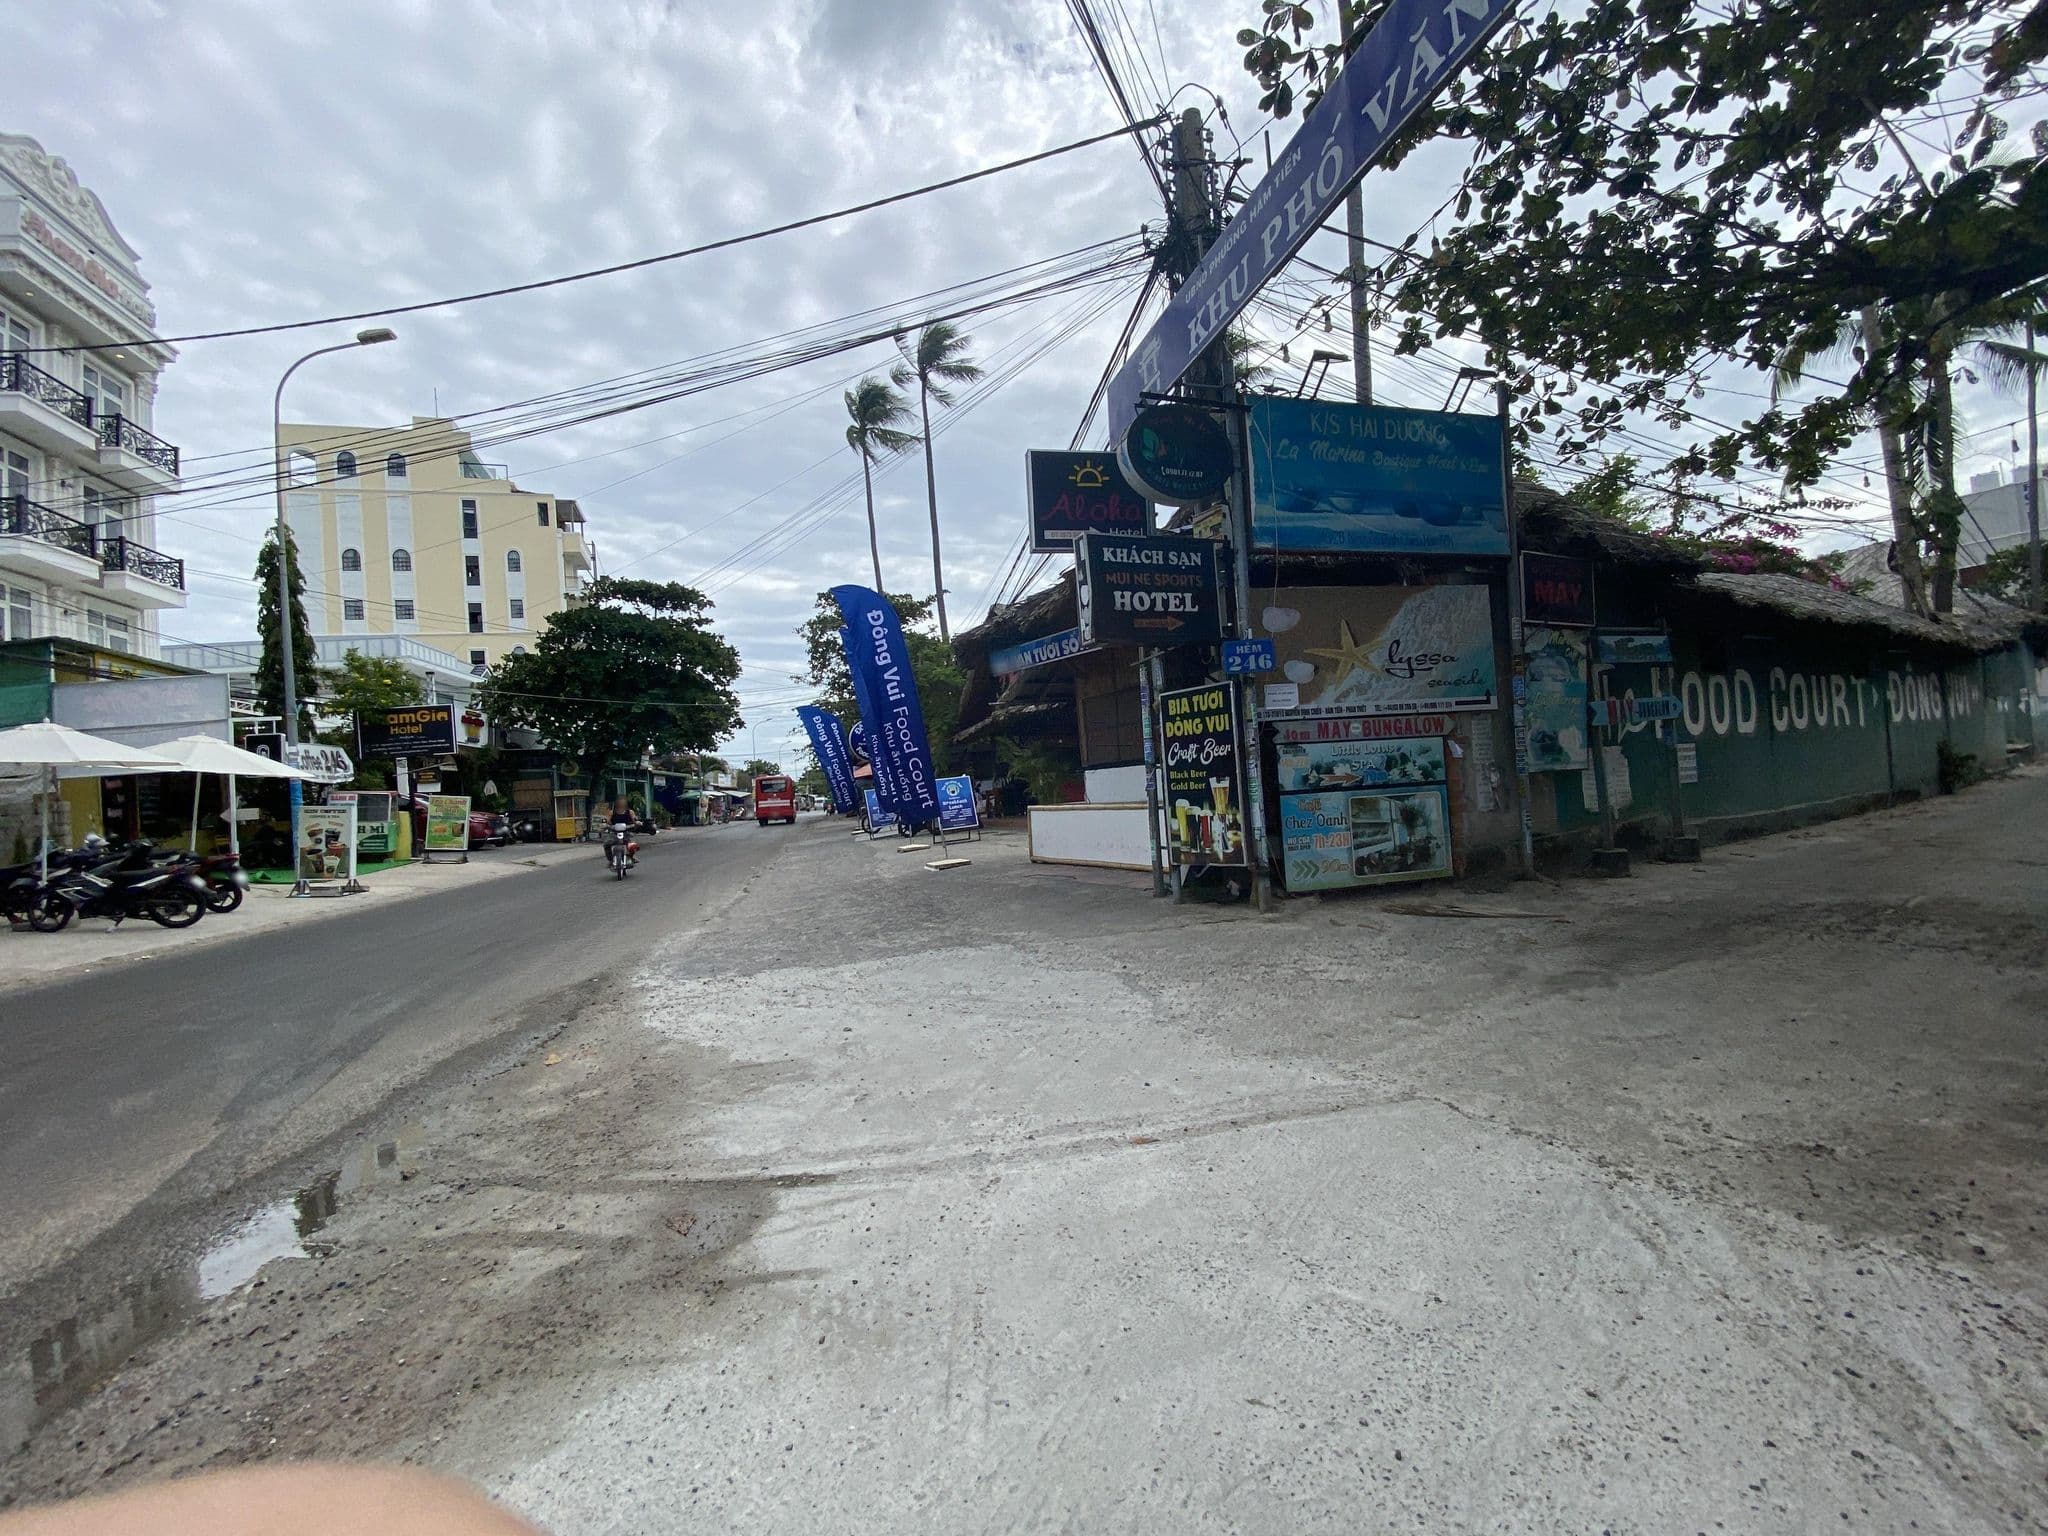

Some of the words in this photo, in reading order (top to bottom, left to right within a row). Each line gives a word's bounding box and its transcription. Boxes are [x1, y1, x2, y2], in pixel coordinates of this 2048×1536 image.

[1187, 254, 1250, 354] KHU
[1261, 113, 1344, 270] PHỐ
[1110, 528, 1145, 538] Hotel
[1102, 545, 1164, 565] KHÁCH
[1168, 551, 1202, 570] SẠN
[1112, 590, 1199, 612] HOTEL
[1534, 581, 1583, 607] MAY
[866, 609, 892, 666] Đông
[1228, 653, 1273, 672] 246
[883, 666, 906, 701] Vui
[1168, 697, 1191, 716] BIA
[1192, 690, 1224, 712] TƯƠI
[1769, 666, 1866, 733] COURT
[1887, 661, 1943, 723] ĐÔNG
[390, 723, 423, 735] Hotel
[893, 706, 919, 754] Food
[1205, 713, 1230, 734] VUI
[1317, 720, 1351, 740] MAY
[1361, 716, 1445, 738] BUNGALOW
[883, 722, 900, 748] Khu
[898, 769, 913, 802] uống
[1167, 742, 1200, 766] Craft
[1200, 738, 1232, 765] Beer
[1331, 744, 1361, 757] Little
[1364, 743, 1397, 755] Lotus
[1170, 770, 1189, 779] Black
[1190, 769, 1208, 778] Beer
[1351, 759, 1377, 772] SPA
[830, 758, 846, 781] Food
[839, 781, 853, 807] Court
[908, 757, 935, 809] Court
[1170, 782, 1189, 790] Gold
[1190, 781, 1207, 790] Beer
[1285, 815, 1313, 830] Chez
[1316, 811, 1348, 827] Oanh
